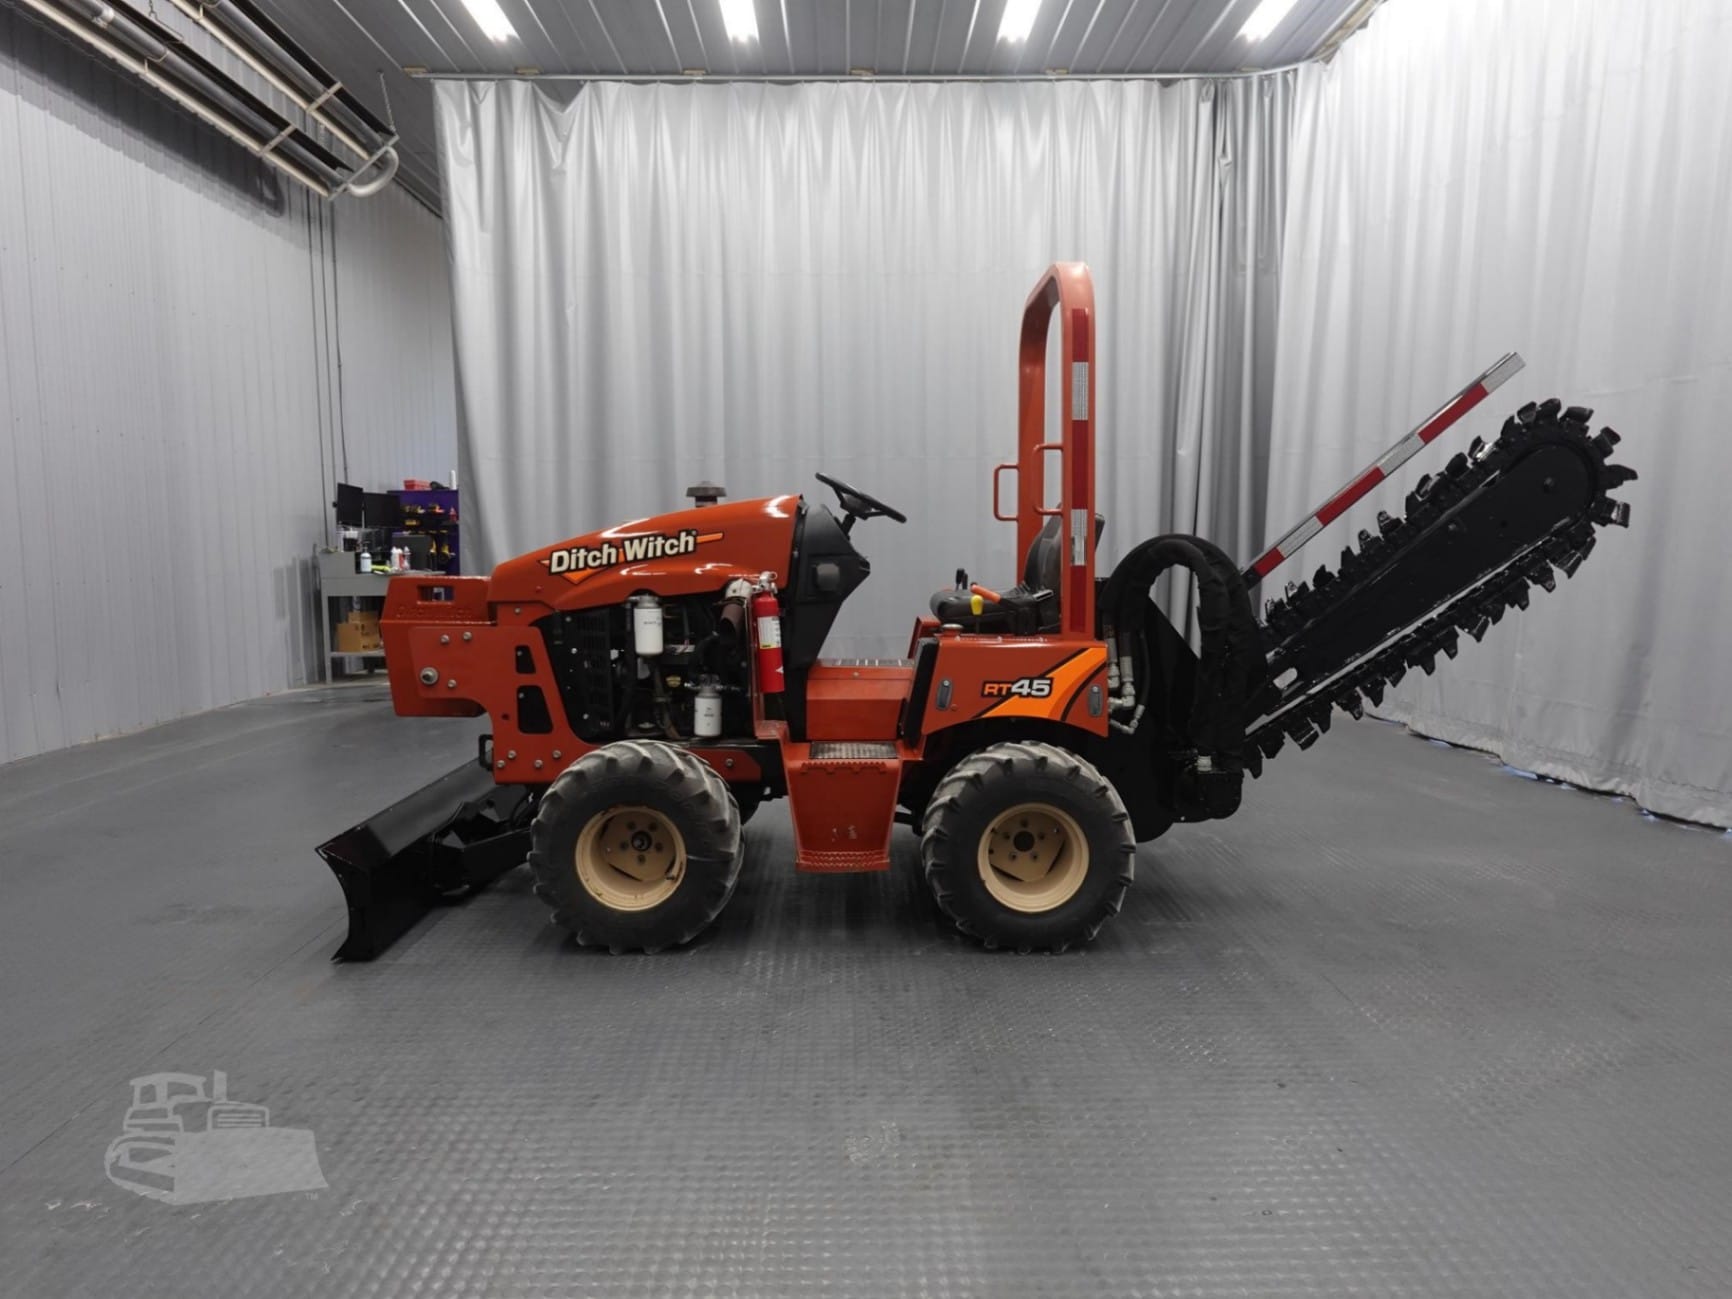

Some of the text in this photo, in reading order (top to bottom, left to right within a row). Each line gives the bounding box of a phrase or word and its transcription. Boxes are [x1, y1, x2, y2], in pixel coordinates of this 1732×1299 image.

[550, 530, 695, 574] Ditch Witch
[983, 679, 1051, 697] RT45
